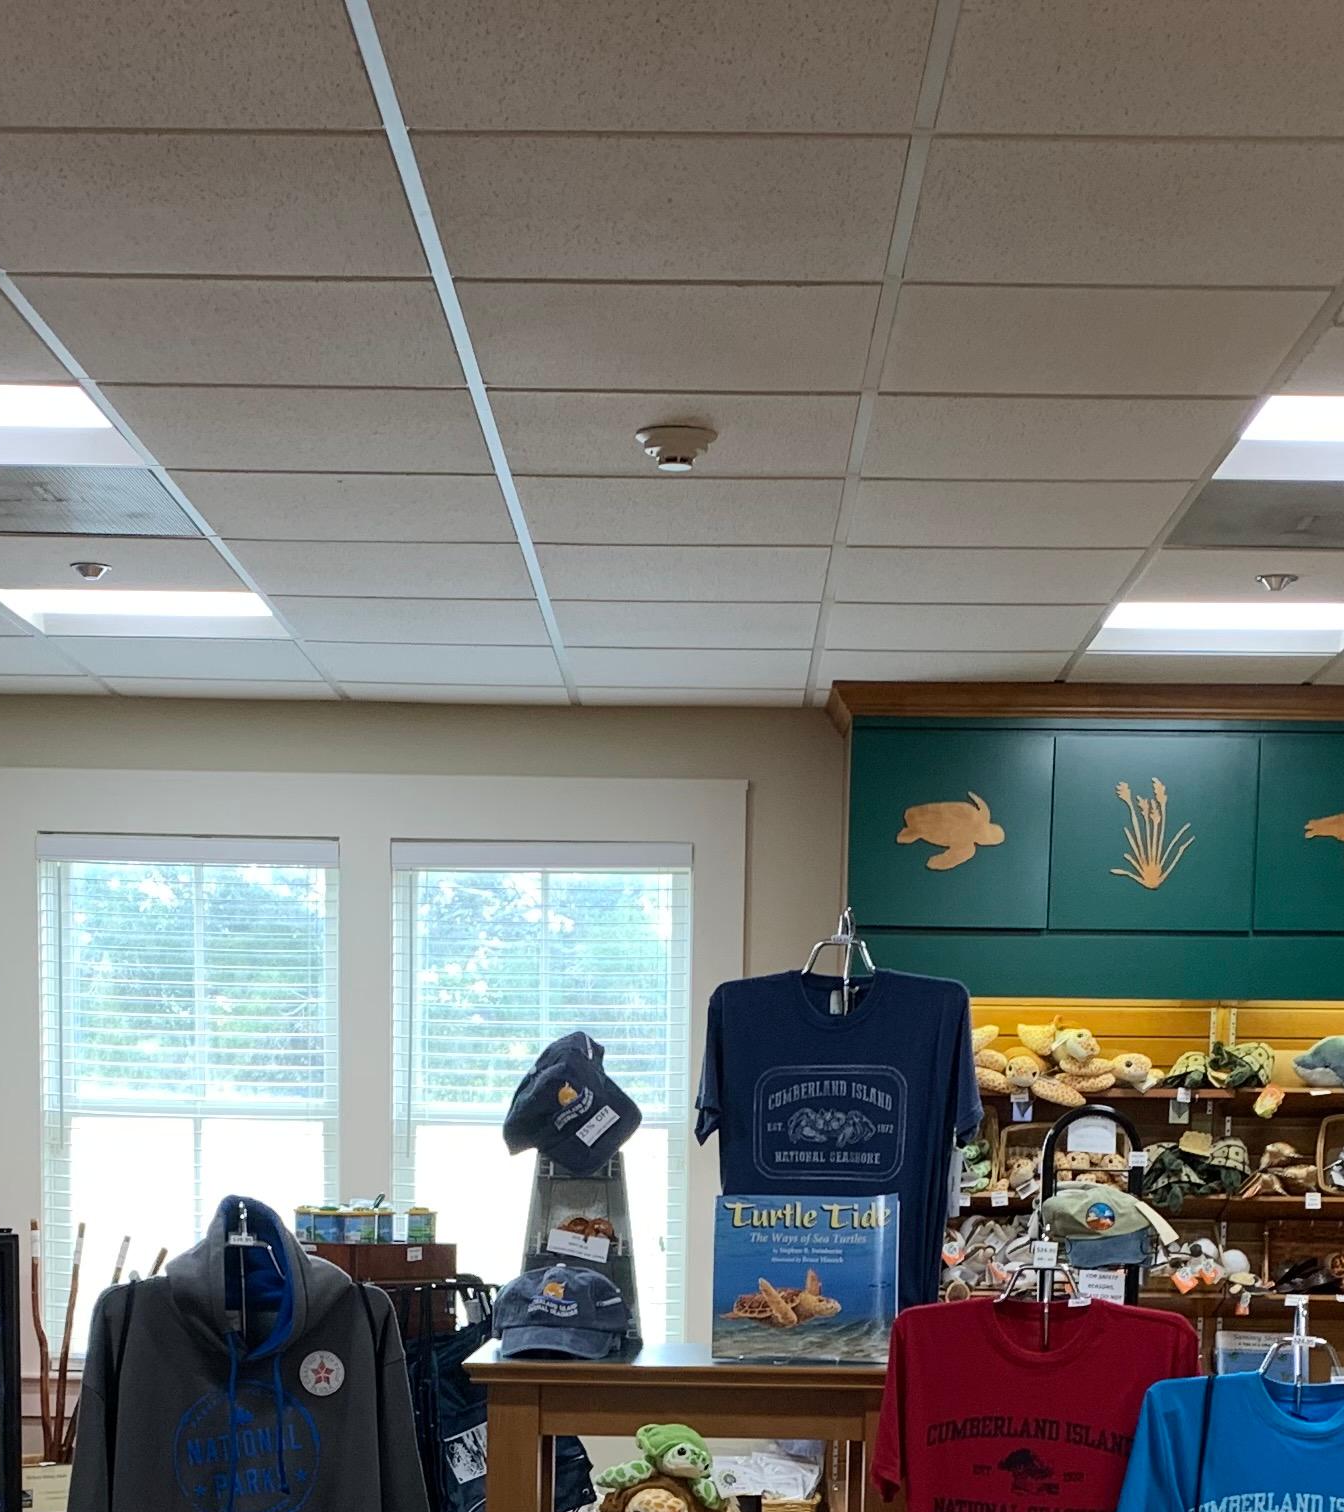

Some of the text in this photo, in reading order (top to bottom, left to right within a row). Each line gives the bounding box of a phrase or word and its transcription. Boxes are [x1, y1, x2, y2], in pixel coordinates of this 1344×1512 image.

[767, 1080, 893, 1112] CUMBERLAND ISLAND
[596, 1107, 609, 1121] OFF
[774, 1150, 881, 1165] NATIONAL SEASHORE
[723, 1201, 892, 1230] Turtle Tide
[750, 1232, 867, 1245] The Ways of Sea Turtles
[187, 1424, 302, 1465] NATONL
[926, 1416, 1060, 1447] CUMBERLAND
[212, 1468, 284, 1499] PARK
